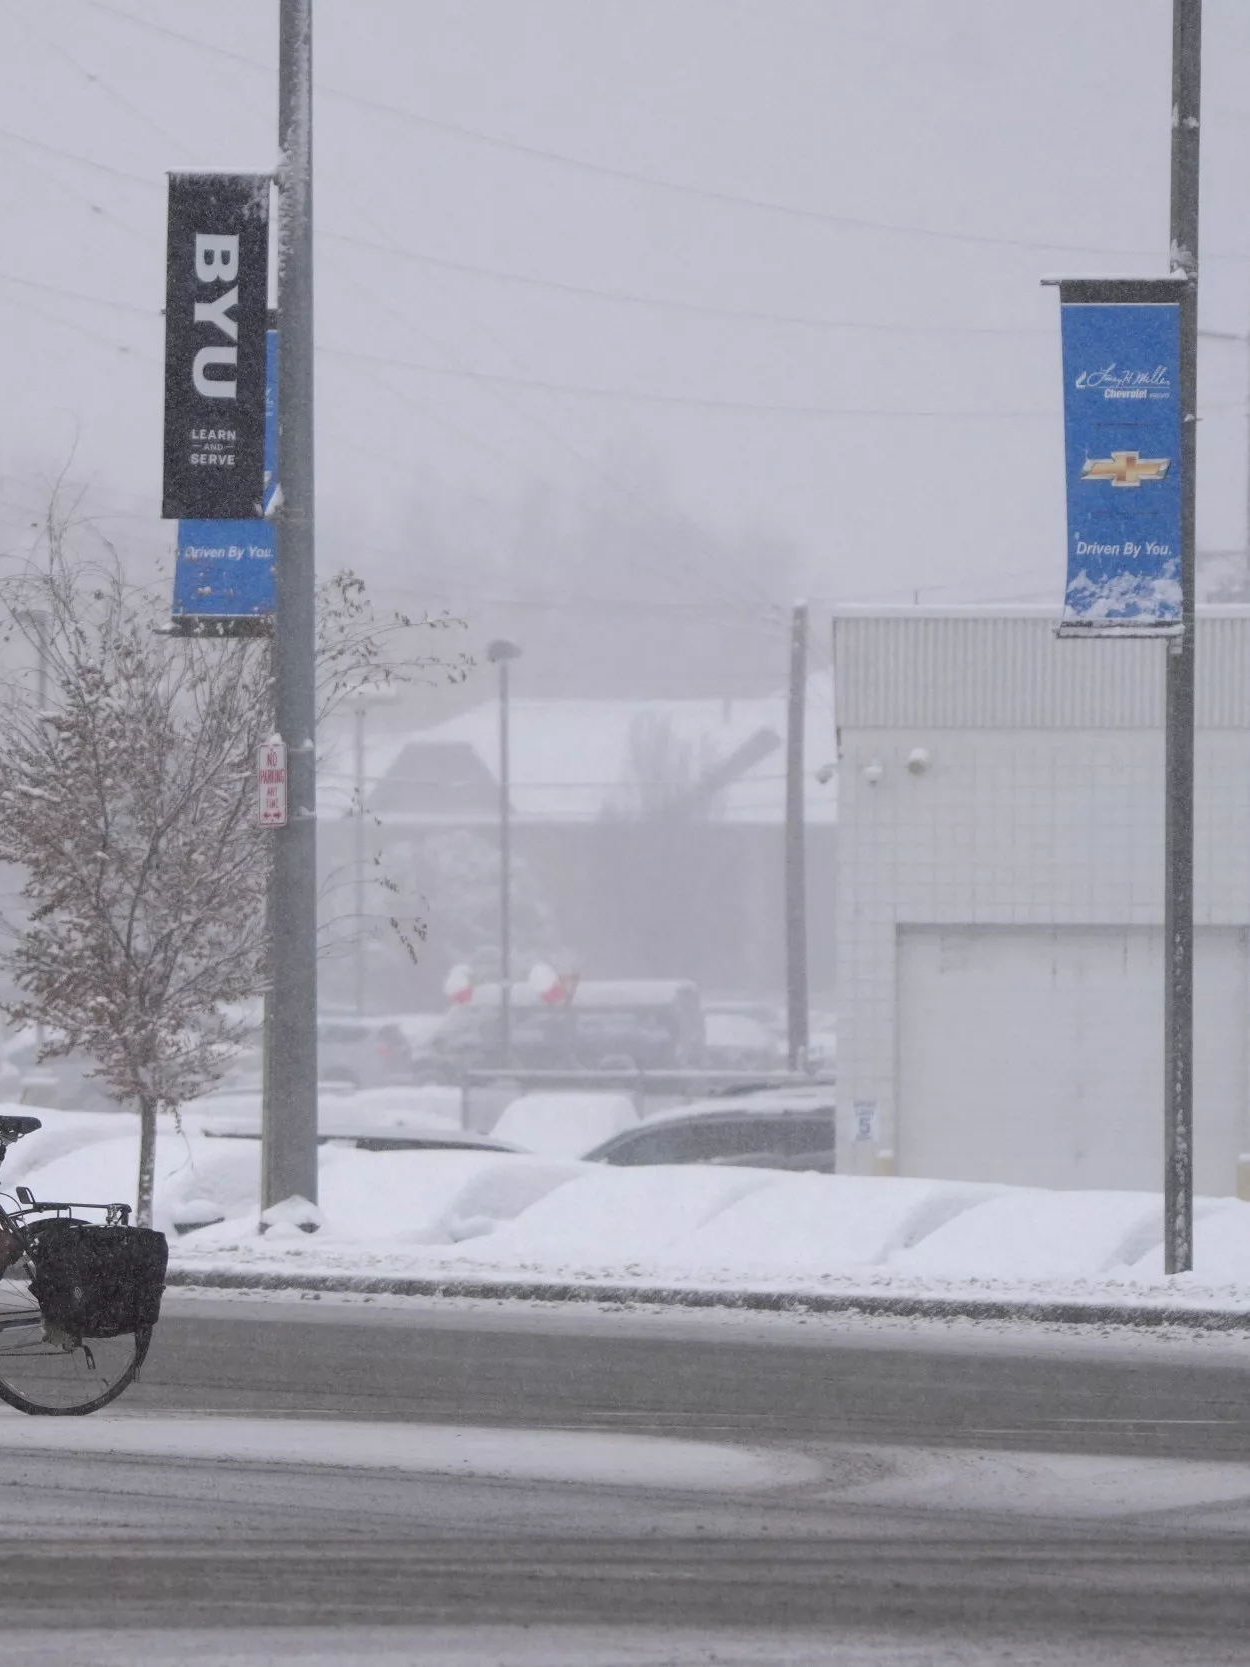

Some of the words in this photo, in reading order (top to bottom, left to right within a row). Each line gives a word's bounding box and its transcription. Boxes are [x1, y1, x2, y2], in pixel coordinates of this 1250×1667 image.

[192, 233, 239, 399] BYU
[1104, 387, 1148, 399] Chevrolet
[191, 429, 236, 441] LEARN
[203, 443, 224, 451] AND
[191, 454, 236, 466] SERVE
[185, 546, 226, 557] Driven
[228, 546, 245, 560] By
[250, 546, 273, 557] You.
[1076, 541, 1120, 555] Driven
[1123, 542, 1142, 558] By
[1145, 541, 1172, 555] You.
[267, 751, 278, 767] NO
[260, 768, 285, 784] PARKING
